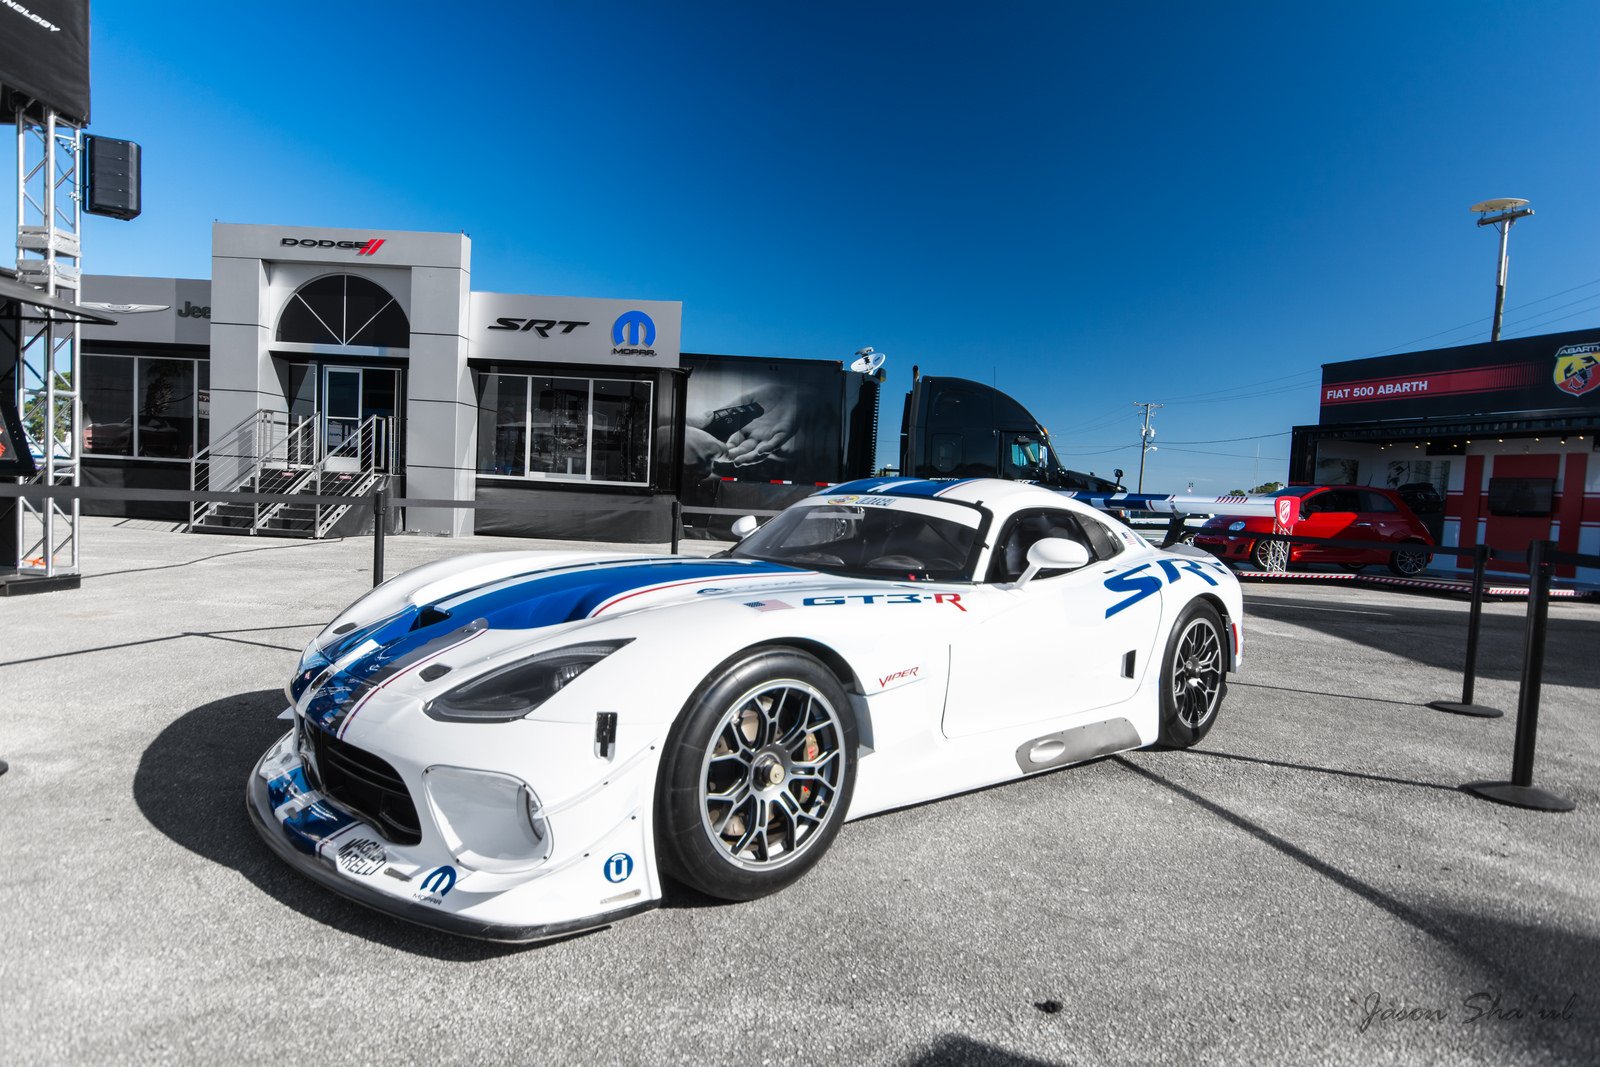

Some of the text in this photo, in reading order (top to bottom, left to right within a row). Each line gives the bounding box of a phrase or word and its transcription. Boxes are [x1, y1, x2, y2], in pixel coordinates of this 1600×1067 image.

[281, 238, 370, 251] DODGE
[487, 317, 590, 338] SRT
[612, 347, 656, 356] MOPAR
[1326, 380, 1428, 399] FIAT 500 ABARTH
[802, 593, 968, 612] GT3-R
[879, 666, 919, 688] VIPER
[412, 892, 443, 905] MOPAR
